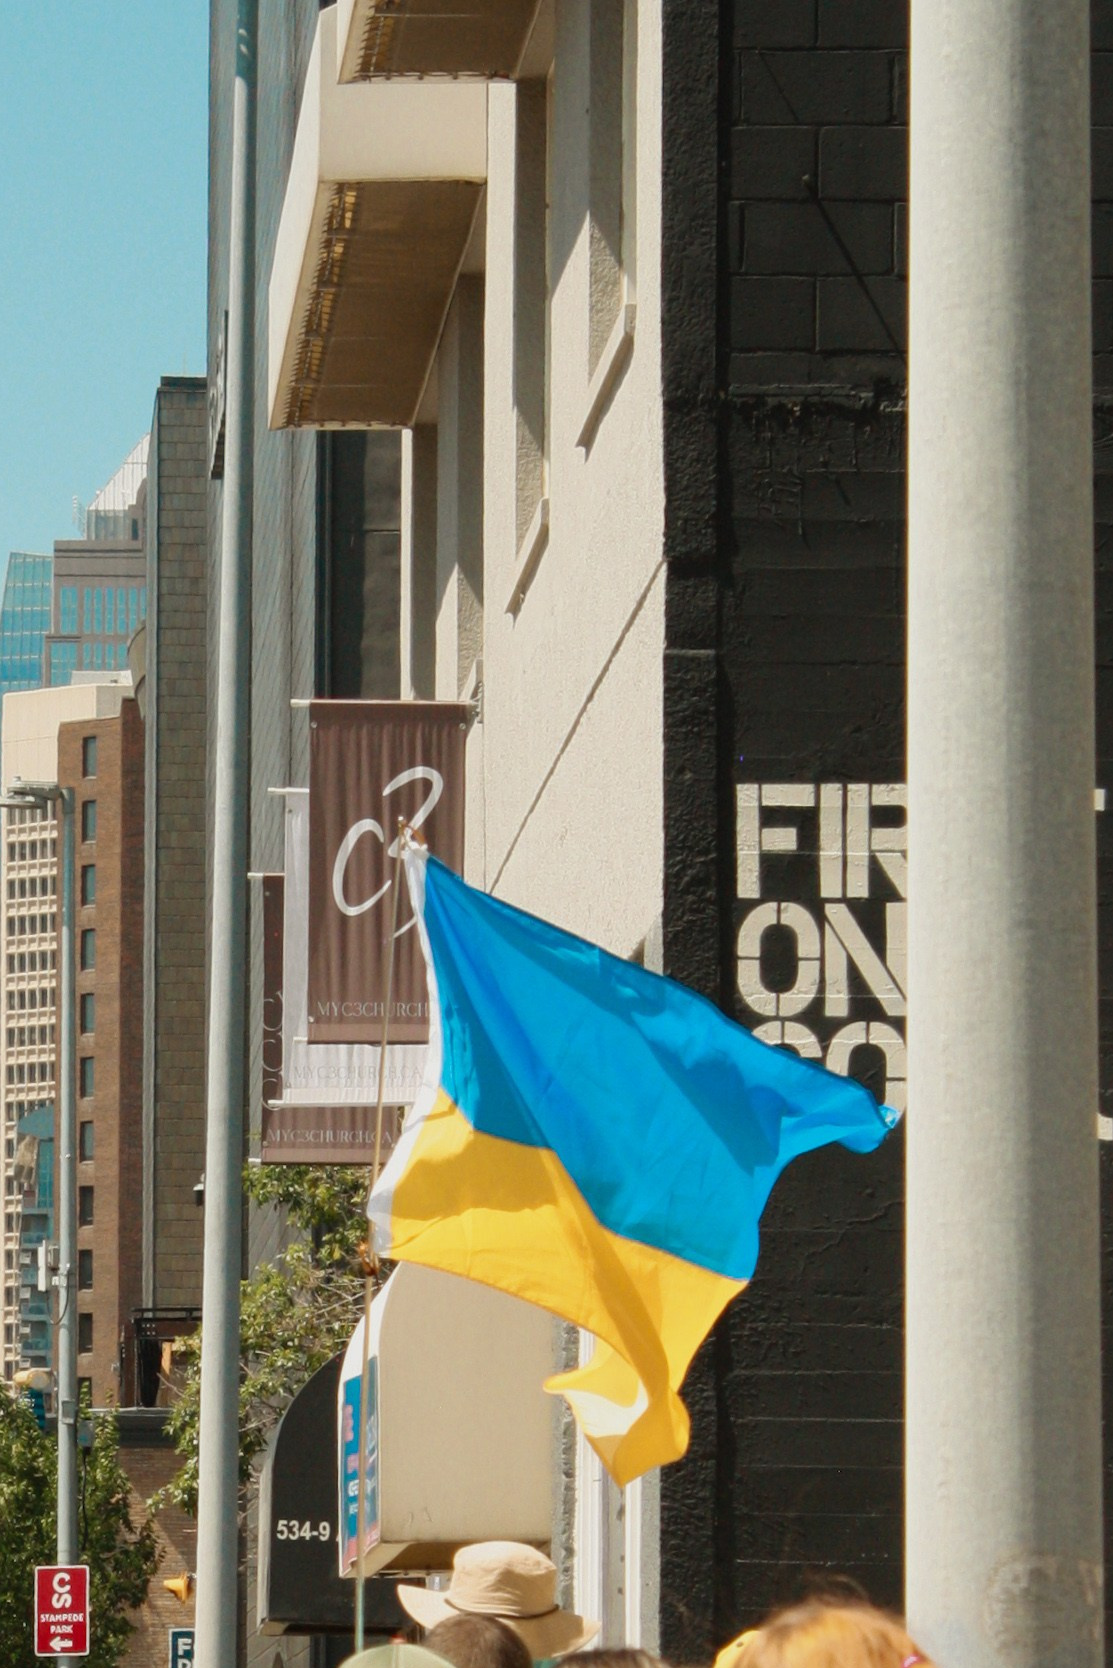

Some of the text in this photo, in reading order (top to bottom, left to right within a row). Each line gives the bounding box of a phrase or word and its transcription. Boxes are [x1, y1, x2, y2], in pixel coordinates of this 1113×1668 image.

[276, 1519, 331, 1541] 534-9
[40, 1613, 84, 1623] STAMPEDE
[50, 1625, 74, 1634] PARK
